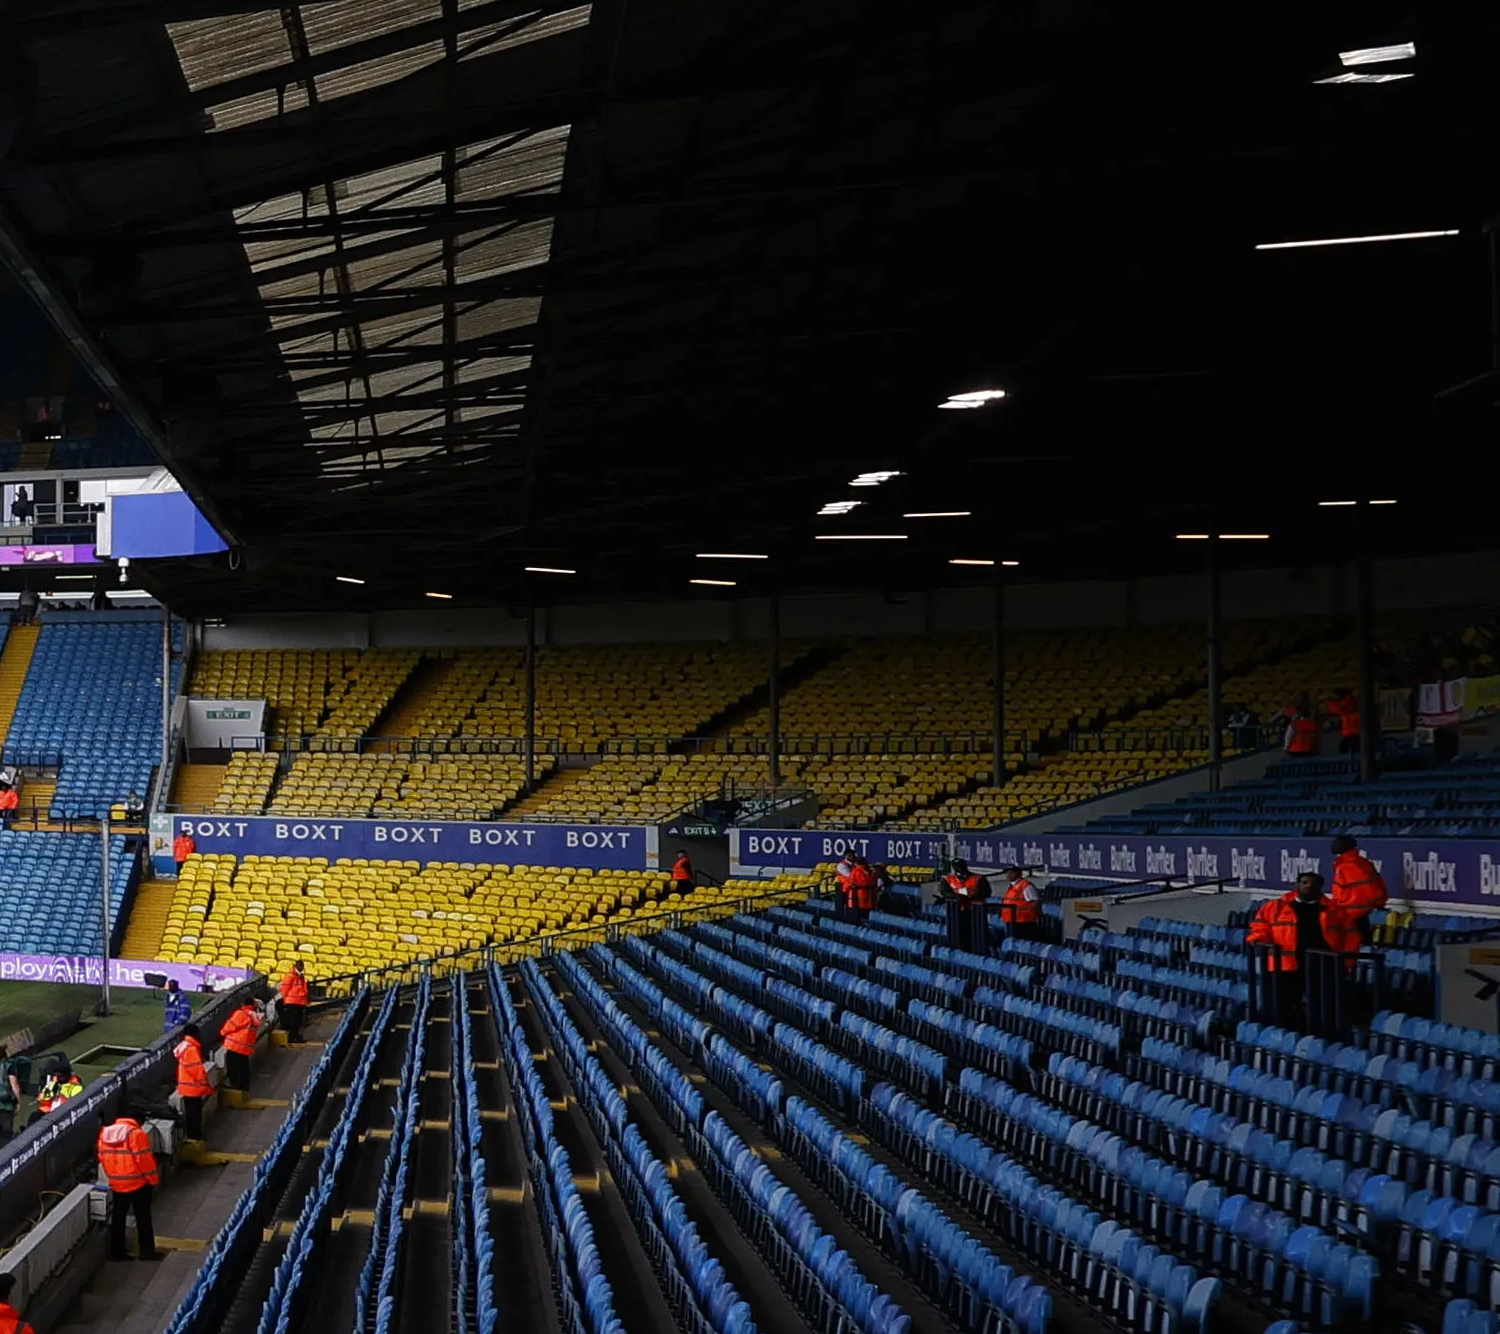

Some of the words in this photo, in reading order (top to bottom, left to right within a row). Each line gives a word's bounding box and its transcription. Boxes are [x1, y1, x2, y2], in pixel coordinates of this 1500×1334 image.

[215, 711, 241, 720] EXIT
[182, 822, 249, 838] BOXT
[276, 824, 343, 840] BOXT
[374, 827, 442, 844] BOXT
[470, 829, 536, 846] BOXT
[684, 827, 703, 835] EXIT
[566, 832, 630, 849] BOXT
[749, 836, 802, 855] BOXT
[822, 839, 870, 857] BOXT
[888, 840, 921, 859] BOXT
[1187, 847, 1217, 877] Burflex
[1232, 848, 1265, 880] Burflex
[1404, 852, 1456, 891] Burflex
